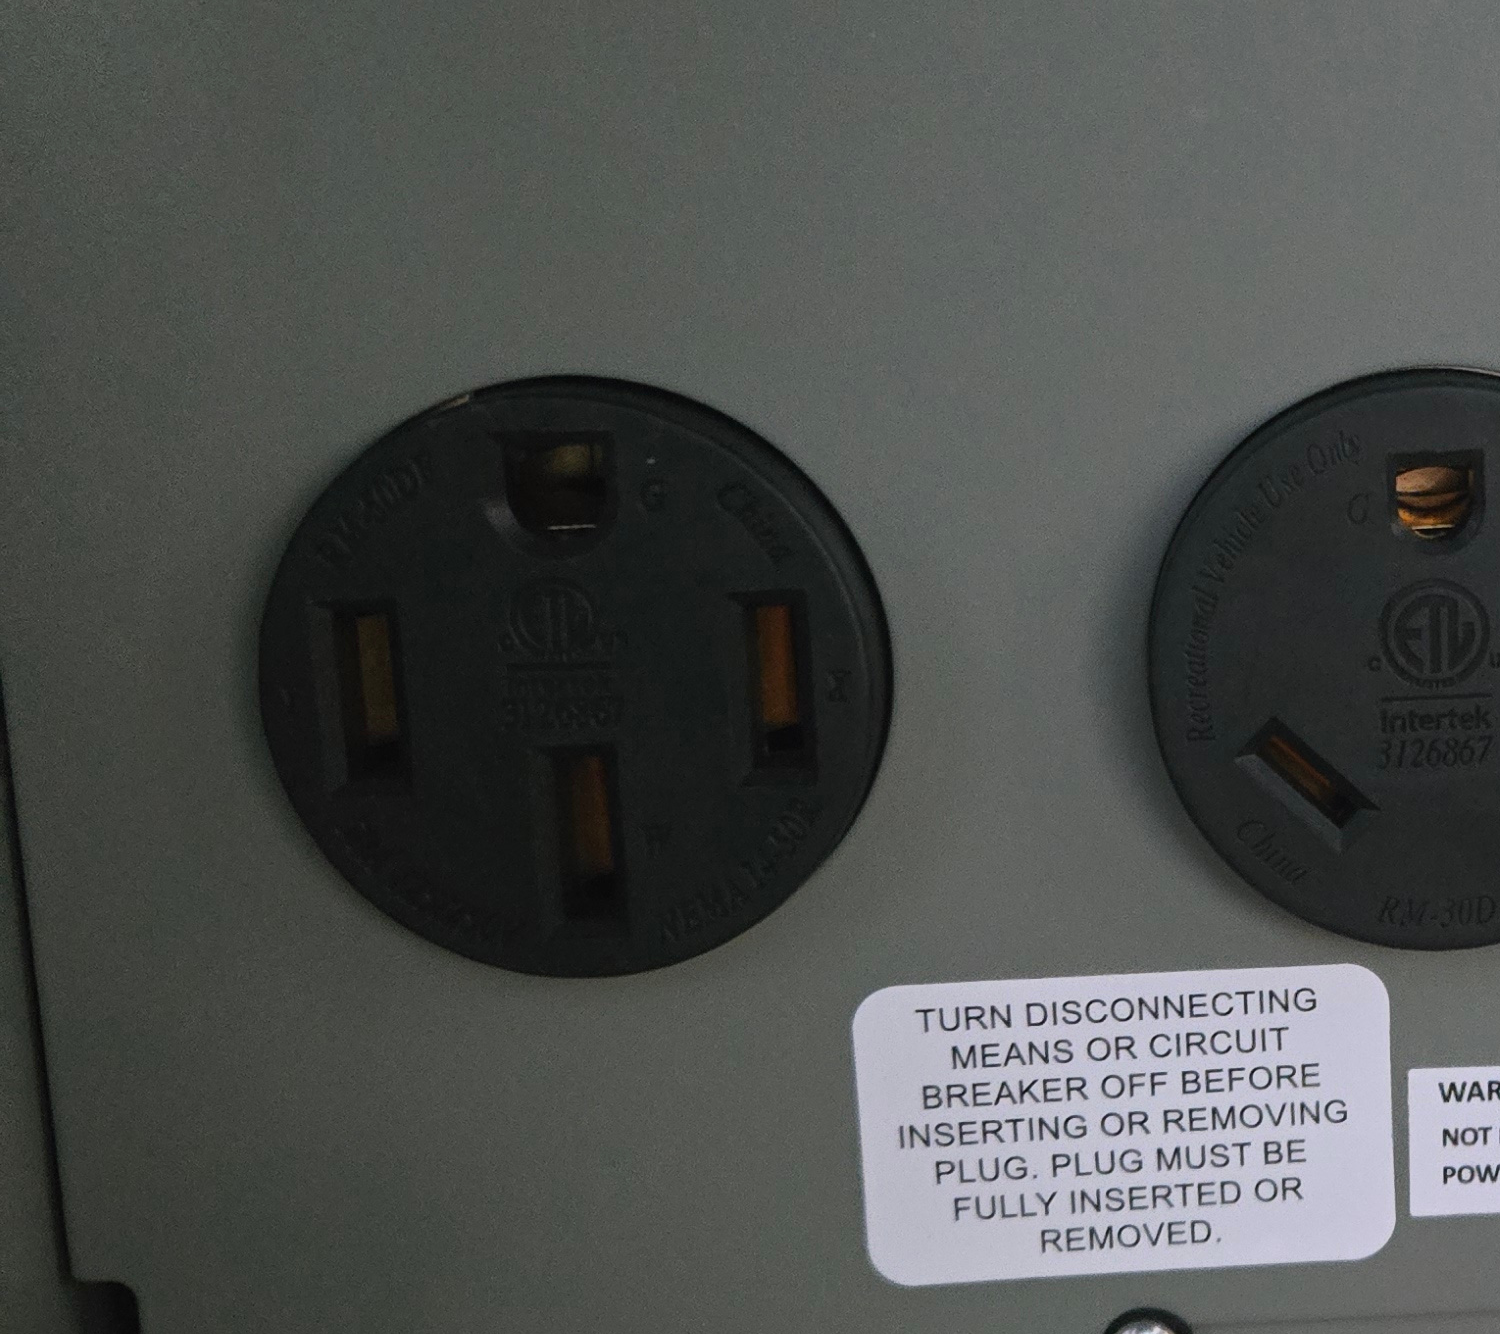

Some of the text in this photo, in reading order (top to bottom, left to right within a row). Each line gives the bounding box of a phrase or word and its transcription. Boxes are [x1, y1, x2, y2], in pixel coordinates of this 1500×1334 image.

[1184, 430, 1361, 745] Recreational Vehicle Use Only
[1379, 704, 1493, 734] Intertek
[1377, 735, 1494, 770] 3126867
[1235, 817, 1310, 886] China
[656, 872, 752, 945] NEMA
[916, 987, 1318, 1034] TURN DISCONNECTING
[951, 1026, 1290, 1070] MEANS OR CIRCUIT
[921, 1063, 1321, 1111] BREAKER OFF BEFORE
[899, 1098, 1349, 1150] INSERTING OR REMOVING
[1442, 1125, 1492, 1147] NOT
[935, 1138, 1307, 1185] PLUG. PLUG MUST BE
[952, 1177, 1304, 1222] FULLY INSERTED OR
[1040, 1220, 1223, 1255] REMOVED.
